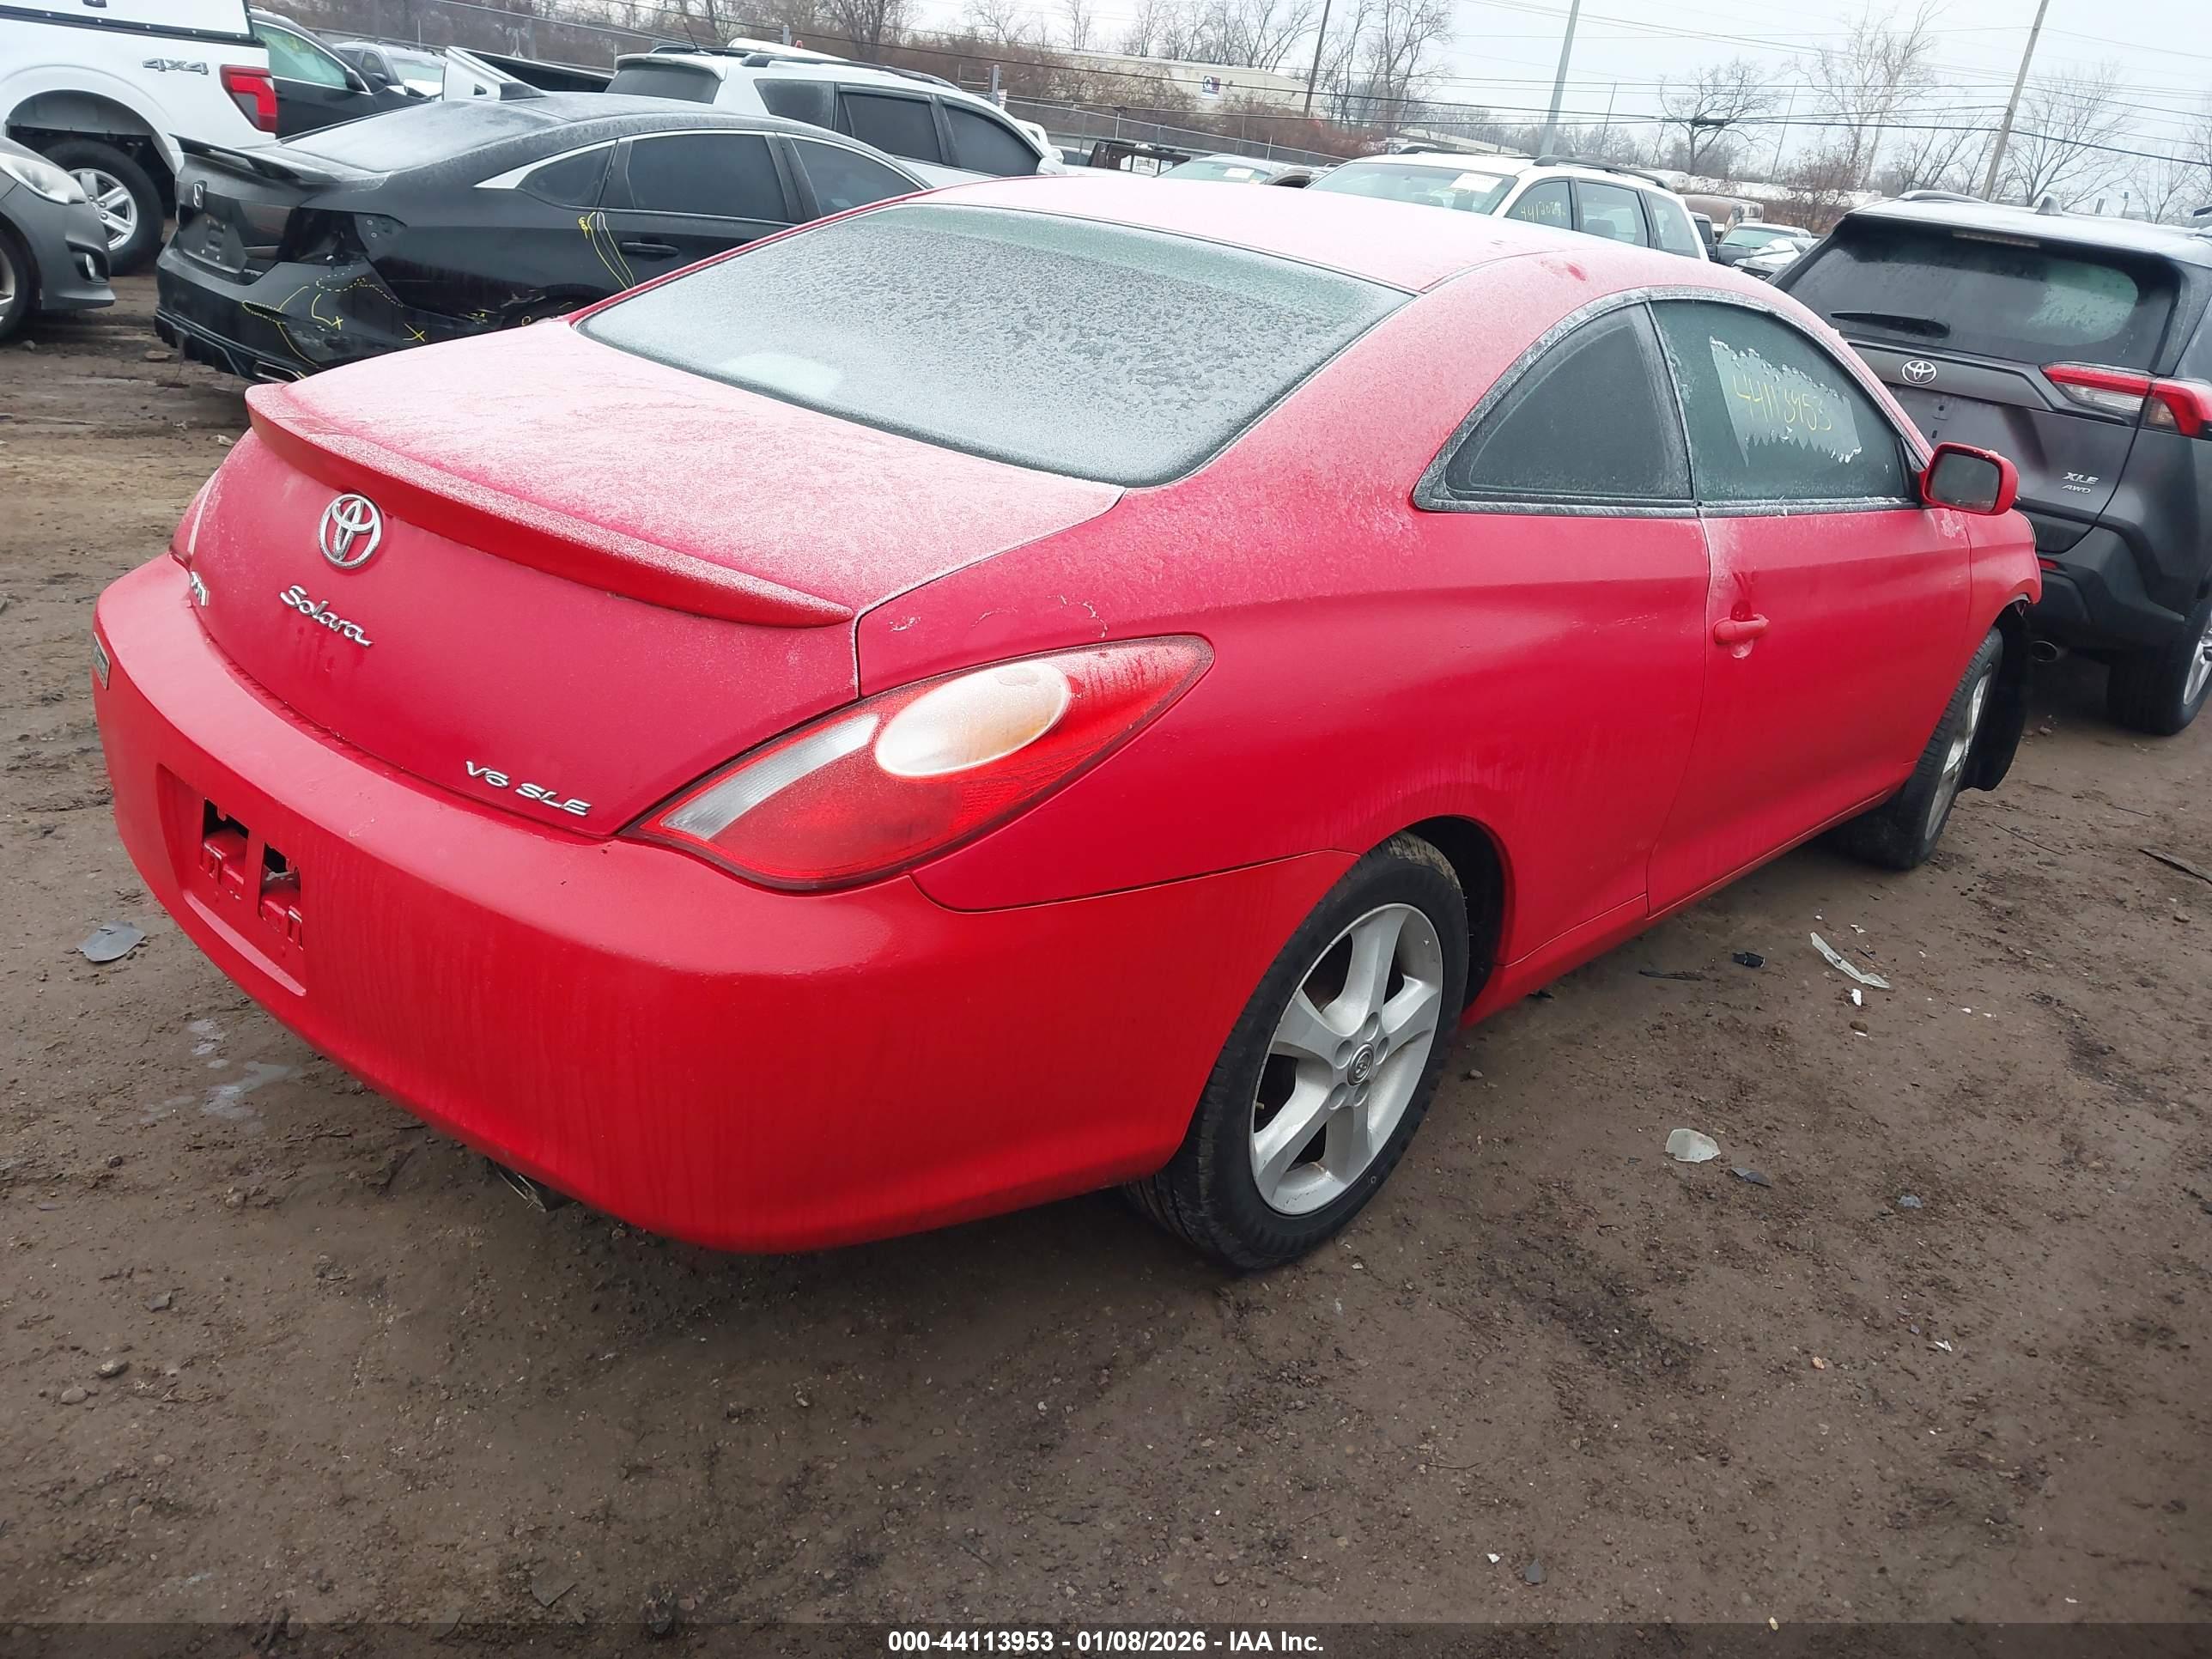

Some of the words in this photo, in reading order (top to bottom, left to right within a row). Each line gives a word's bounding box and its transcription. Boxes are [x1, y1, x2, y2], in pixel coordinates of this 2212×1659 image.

[2061, 484, 2092, 495] AWD
[2062, 471, 2100, 486] XLE
[279, 584, 377, 647] Solara
[465, 760, 511, 788] V6
[514, 781, 593, 817] SLE
